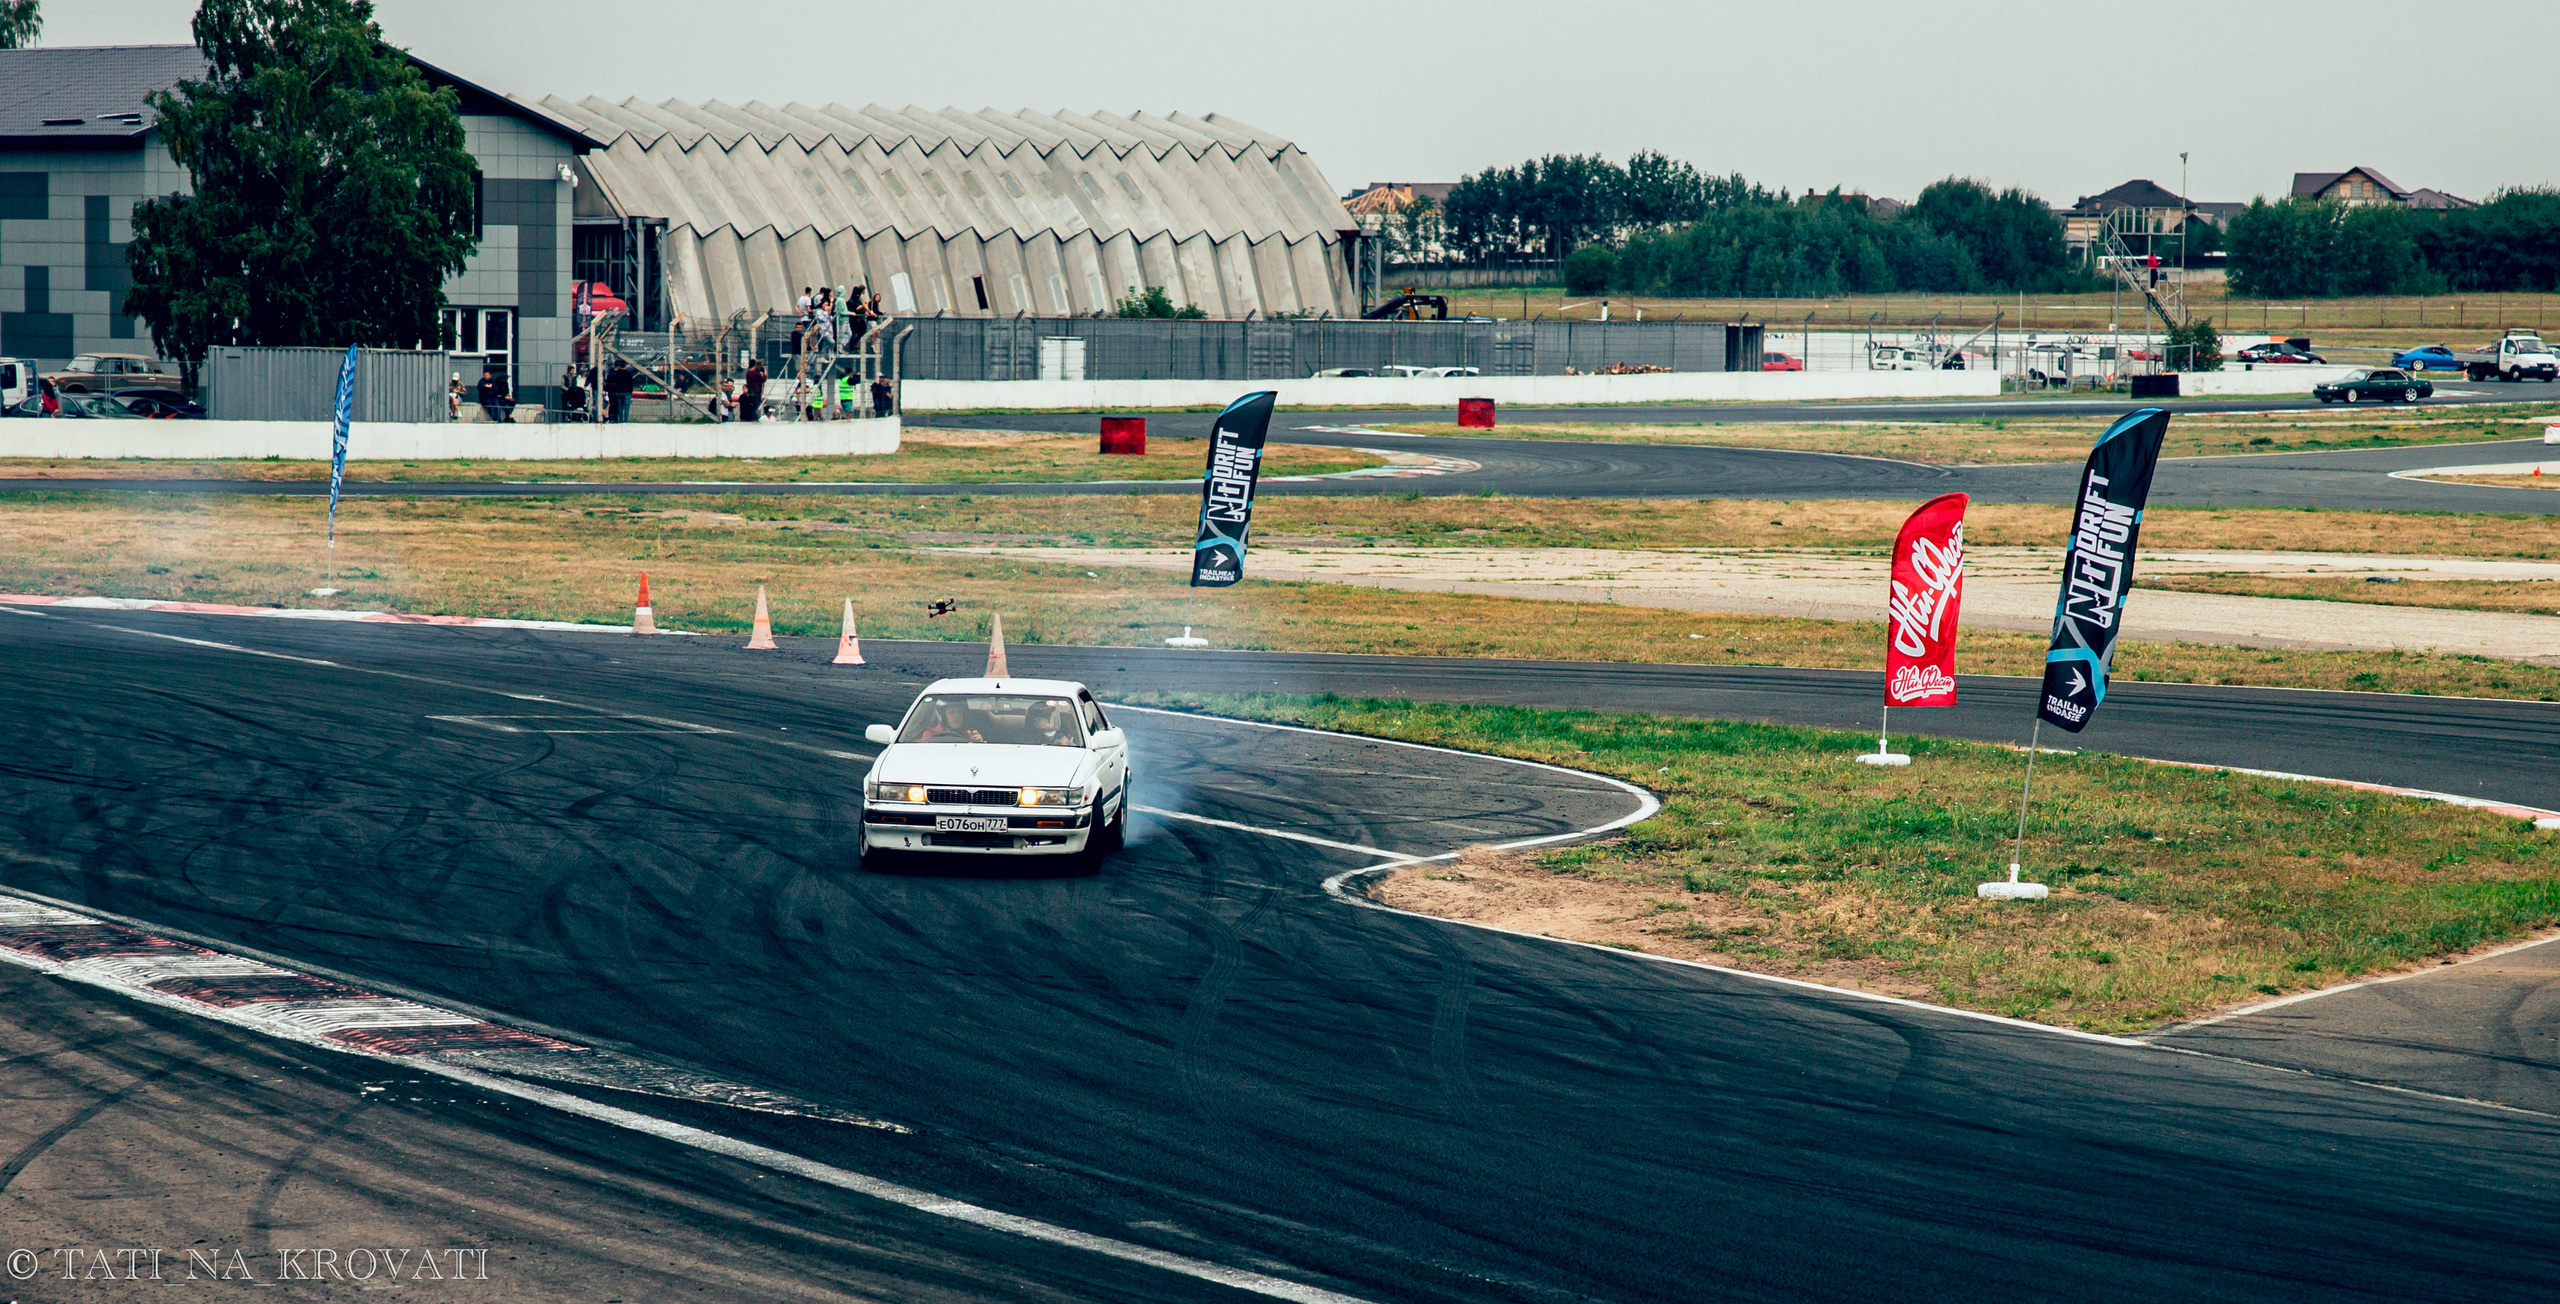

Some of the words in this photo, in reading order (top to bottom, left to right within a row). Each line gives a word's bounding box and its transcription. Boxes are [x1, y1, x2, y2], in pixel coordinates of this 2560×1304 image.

[2066, 335, 2089, 344] ADM
[1212, 427, 1239, 479] DRIFT
[1233, 446, 1256, 480] FUN
[2076, 469, 2110, 553] DRIFT
[2096, 501, 2135, 556] FUN
[987, 819, 1004, 828] 777
